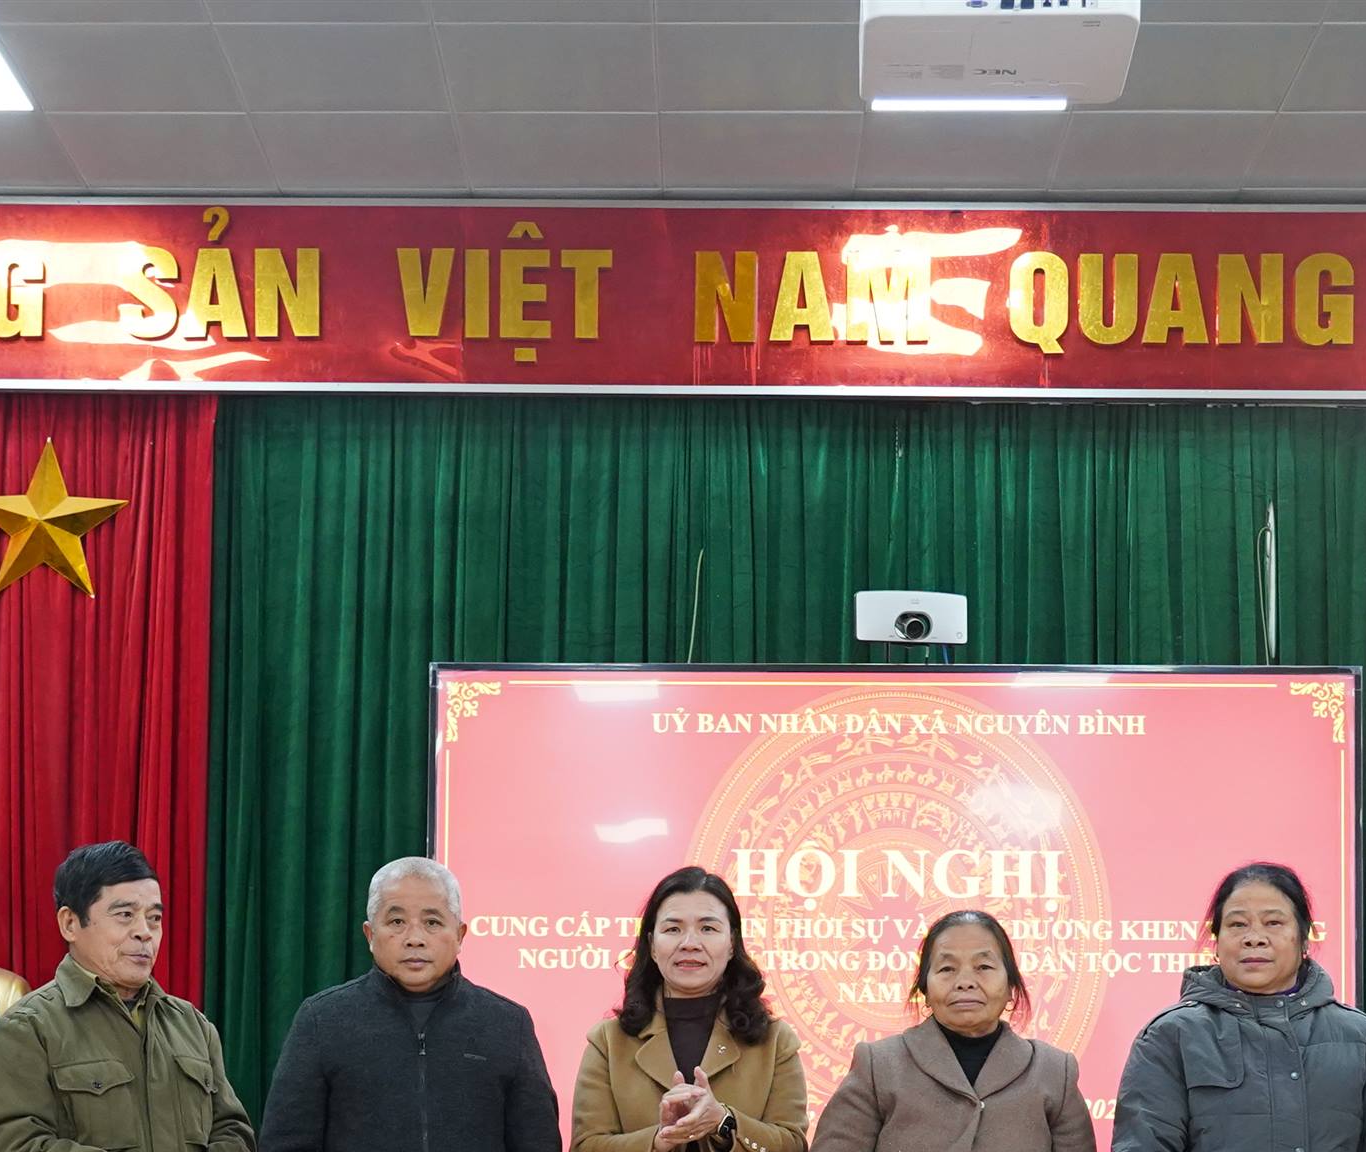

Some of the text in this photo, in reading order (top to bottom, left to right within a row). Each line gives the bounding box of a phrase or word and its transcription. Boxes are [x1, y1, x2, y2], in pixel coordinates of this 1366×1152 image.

[129, 207, 321, 341] SẢN
[396, 221, 613, 362] VIỆT
[694, 250, 931, 345] NAM
[1008, 250, 1355, 355] QUANG
[652, 708, 1146, 735] UỶ BAN NHÂN DÂN XÃ NGUYÊN BÌNH
[732, 840, 1069, 912] HỘI NGHỊ
[470, 916, 549, 937] CUNG
[555, 911, 612, 937] CẤP
[741, 918, 767, 938] IN
[774, 913, 844, 939] THỜI
[851, 915, 889, 944] SỰ
[1012, 916, 1113, 941] DƯƠNG
[1119, 920, 1200, 941] KHEN
[518, 944, 612, 969] NGƯỜI
[764, 950, 860, 971] TRONG
[866, 945, 921, 971] ĐỒN
[1019, 946, 1077, 973] DÂN
[1085, 947, 1141, 977] TỘC
[838, 977, 902, 1003] NĂM
